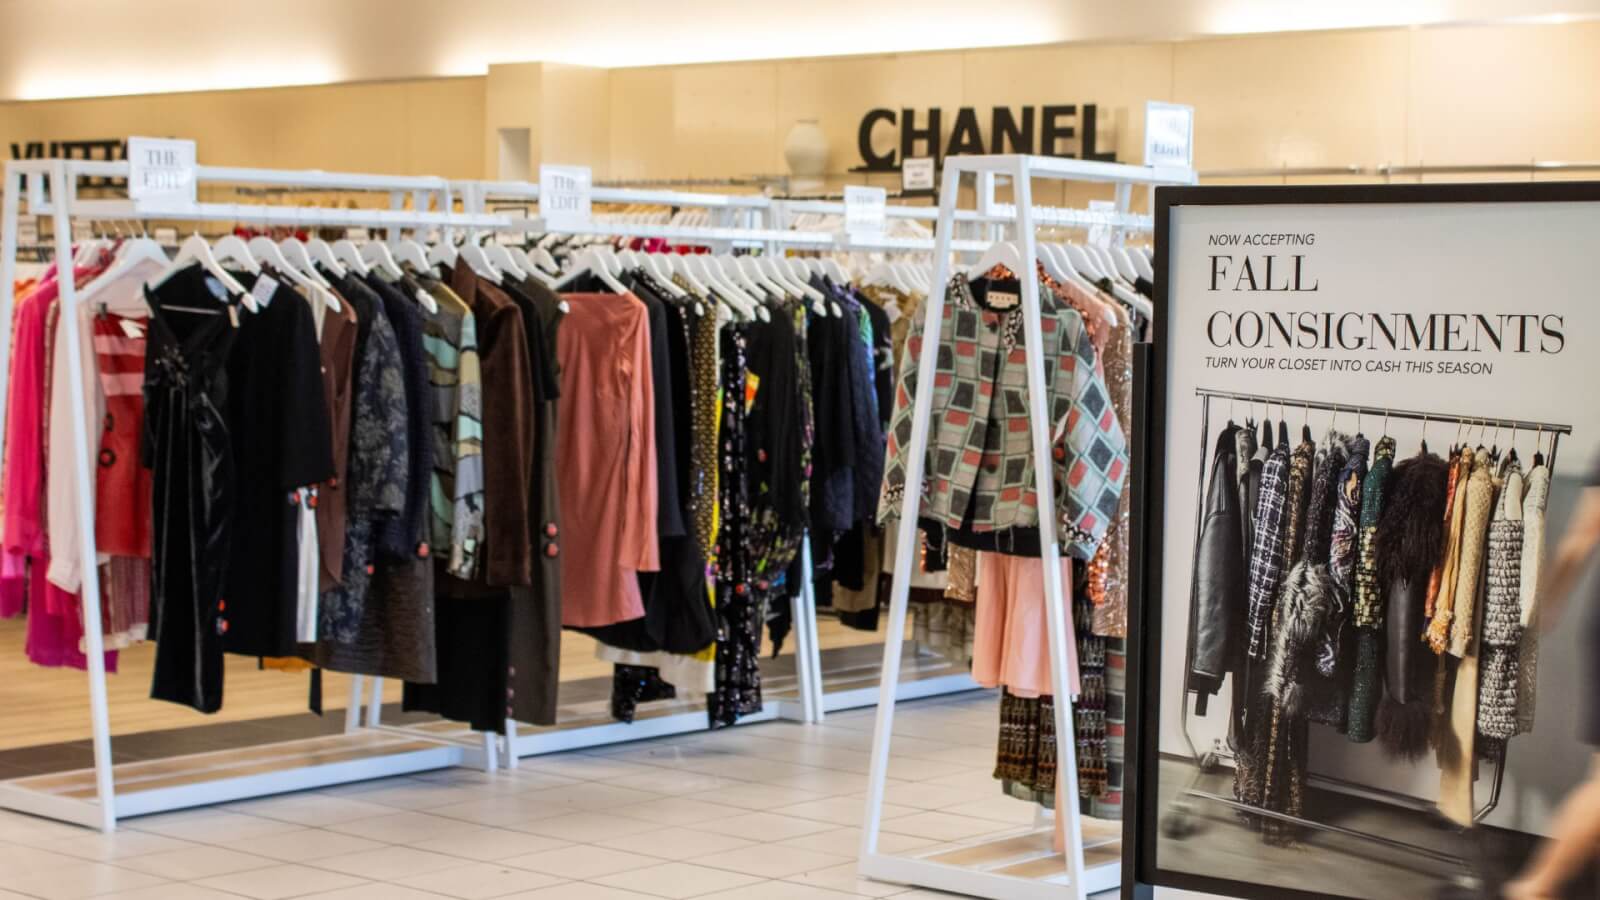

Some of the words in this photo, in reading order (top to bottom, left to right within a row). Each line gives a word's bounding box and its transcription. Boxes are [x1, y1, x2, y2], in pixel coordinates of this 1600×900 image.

[858, 104, 1117, 169] CHANEL
[145, 149, 180, 166] THE
[1208, 234, 1241, 246] NOW
[1243, 233, 1316, 246] ACCEPTING
[1207, 255, 1319, 292] FALL
[1206, 310, 1565, 354] CONSIGNMENTS
[1205, 356, 1238, 369] TURN
[1240, 357, 1276, 370] YOUR
[1278, 358, 1328, 372] CLOSET
[1329, 359, 1362, 373] INTO
[1365, 360, 1402, 373] CASH
[1405, 361, 1433, 374] THIS
[1436, 361, 1493, 375] SEASON
